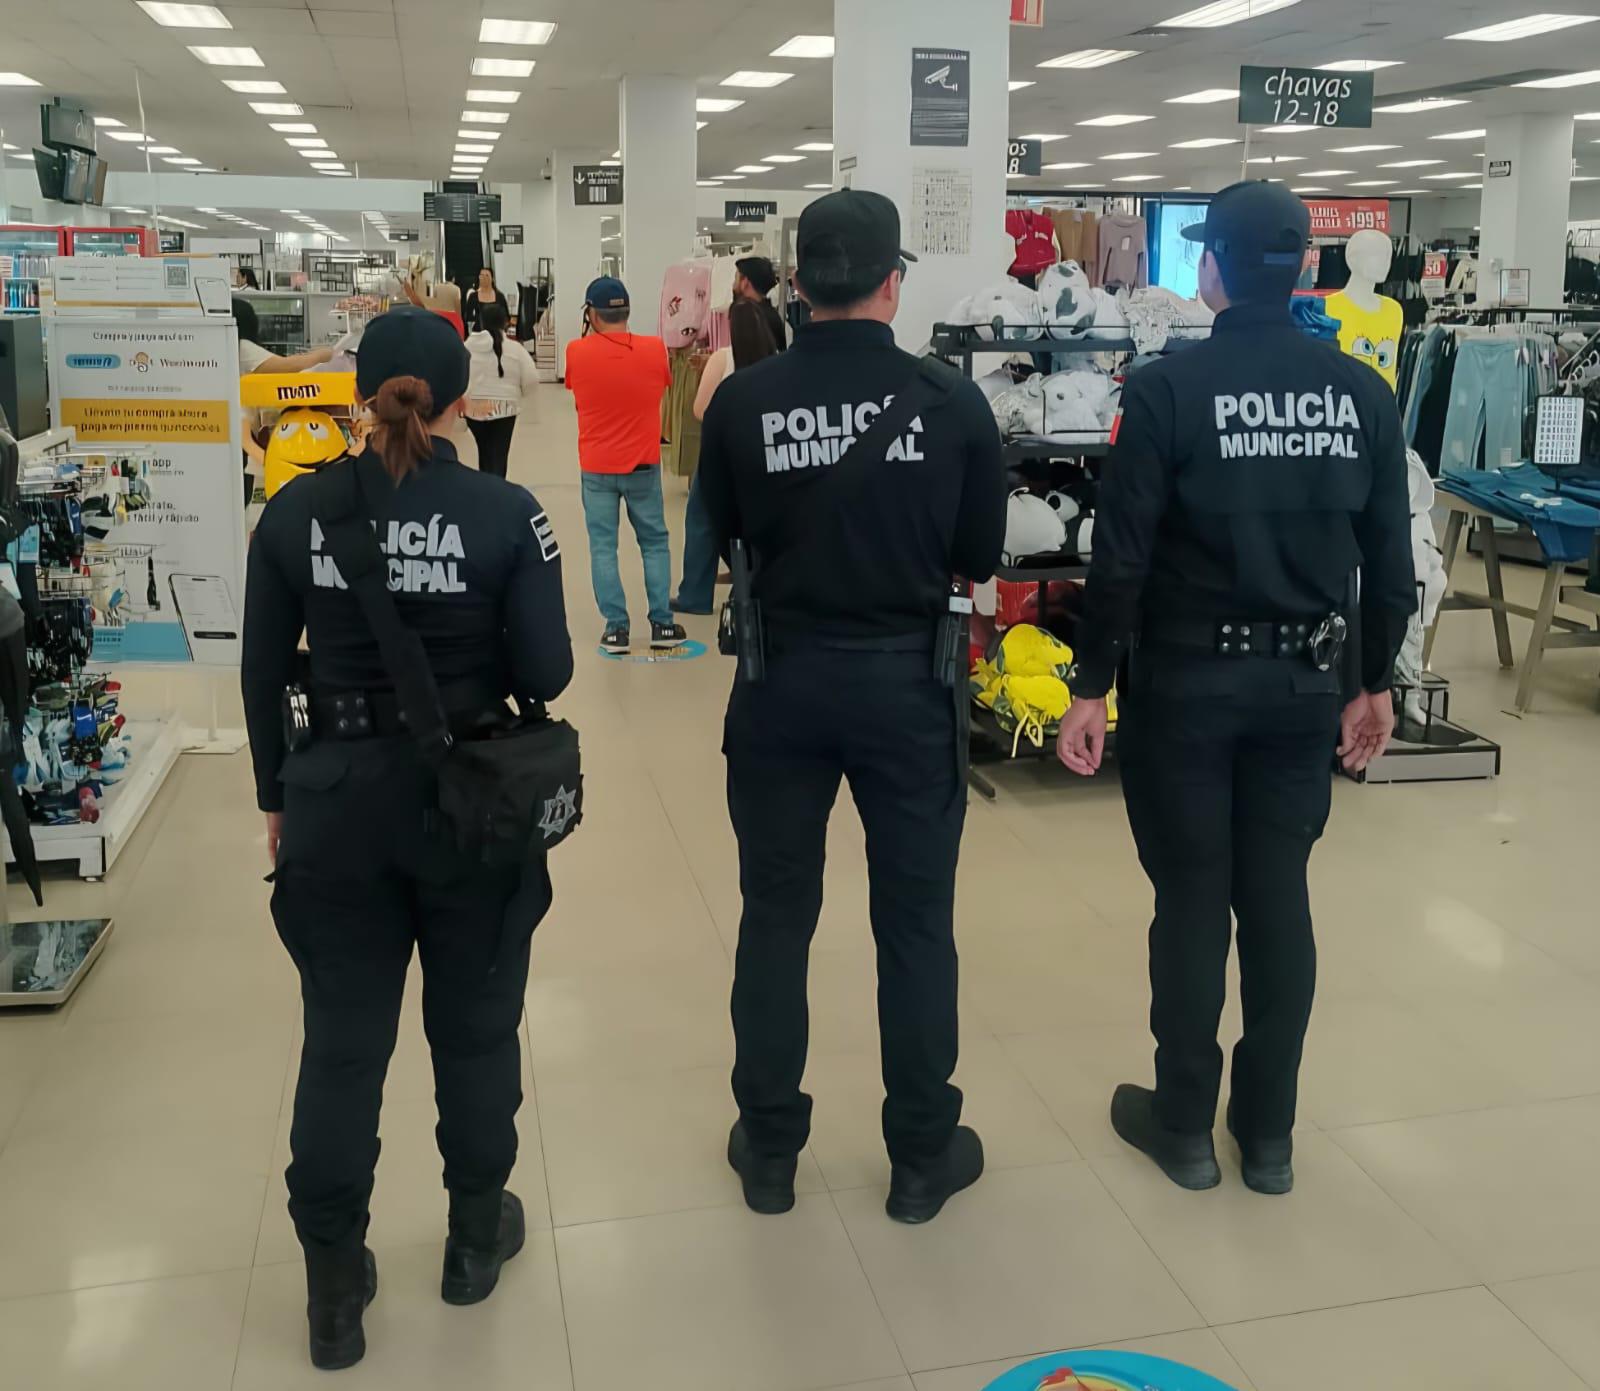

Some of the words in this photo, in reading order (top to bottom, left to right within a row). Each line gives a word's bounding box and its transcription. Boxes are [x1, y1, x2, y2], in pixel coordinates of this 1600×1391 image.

[1264, 68, 1352, 98] chavas
[1274, 99, 1339, 125] 12-18
[761, 394, 924, 445] POLIC
[1214, 385, 1360, 430] POLICÍA
[764, 433, 924, 473] MUNIAL
[1219, 431, 1359, 459] MUNICIPAL
